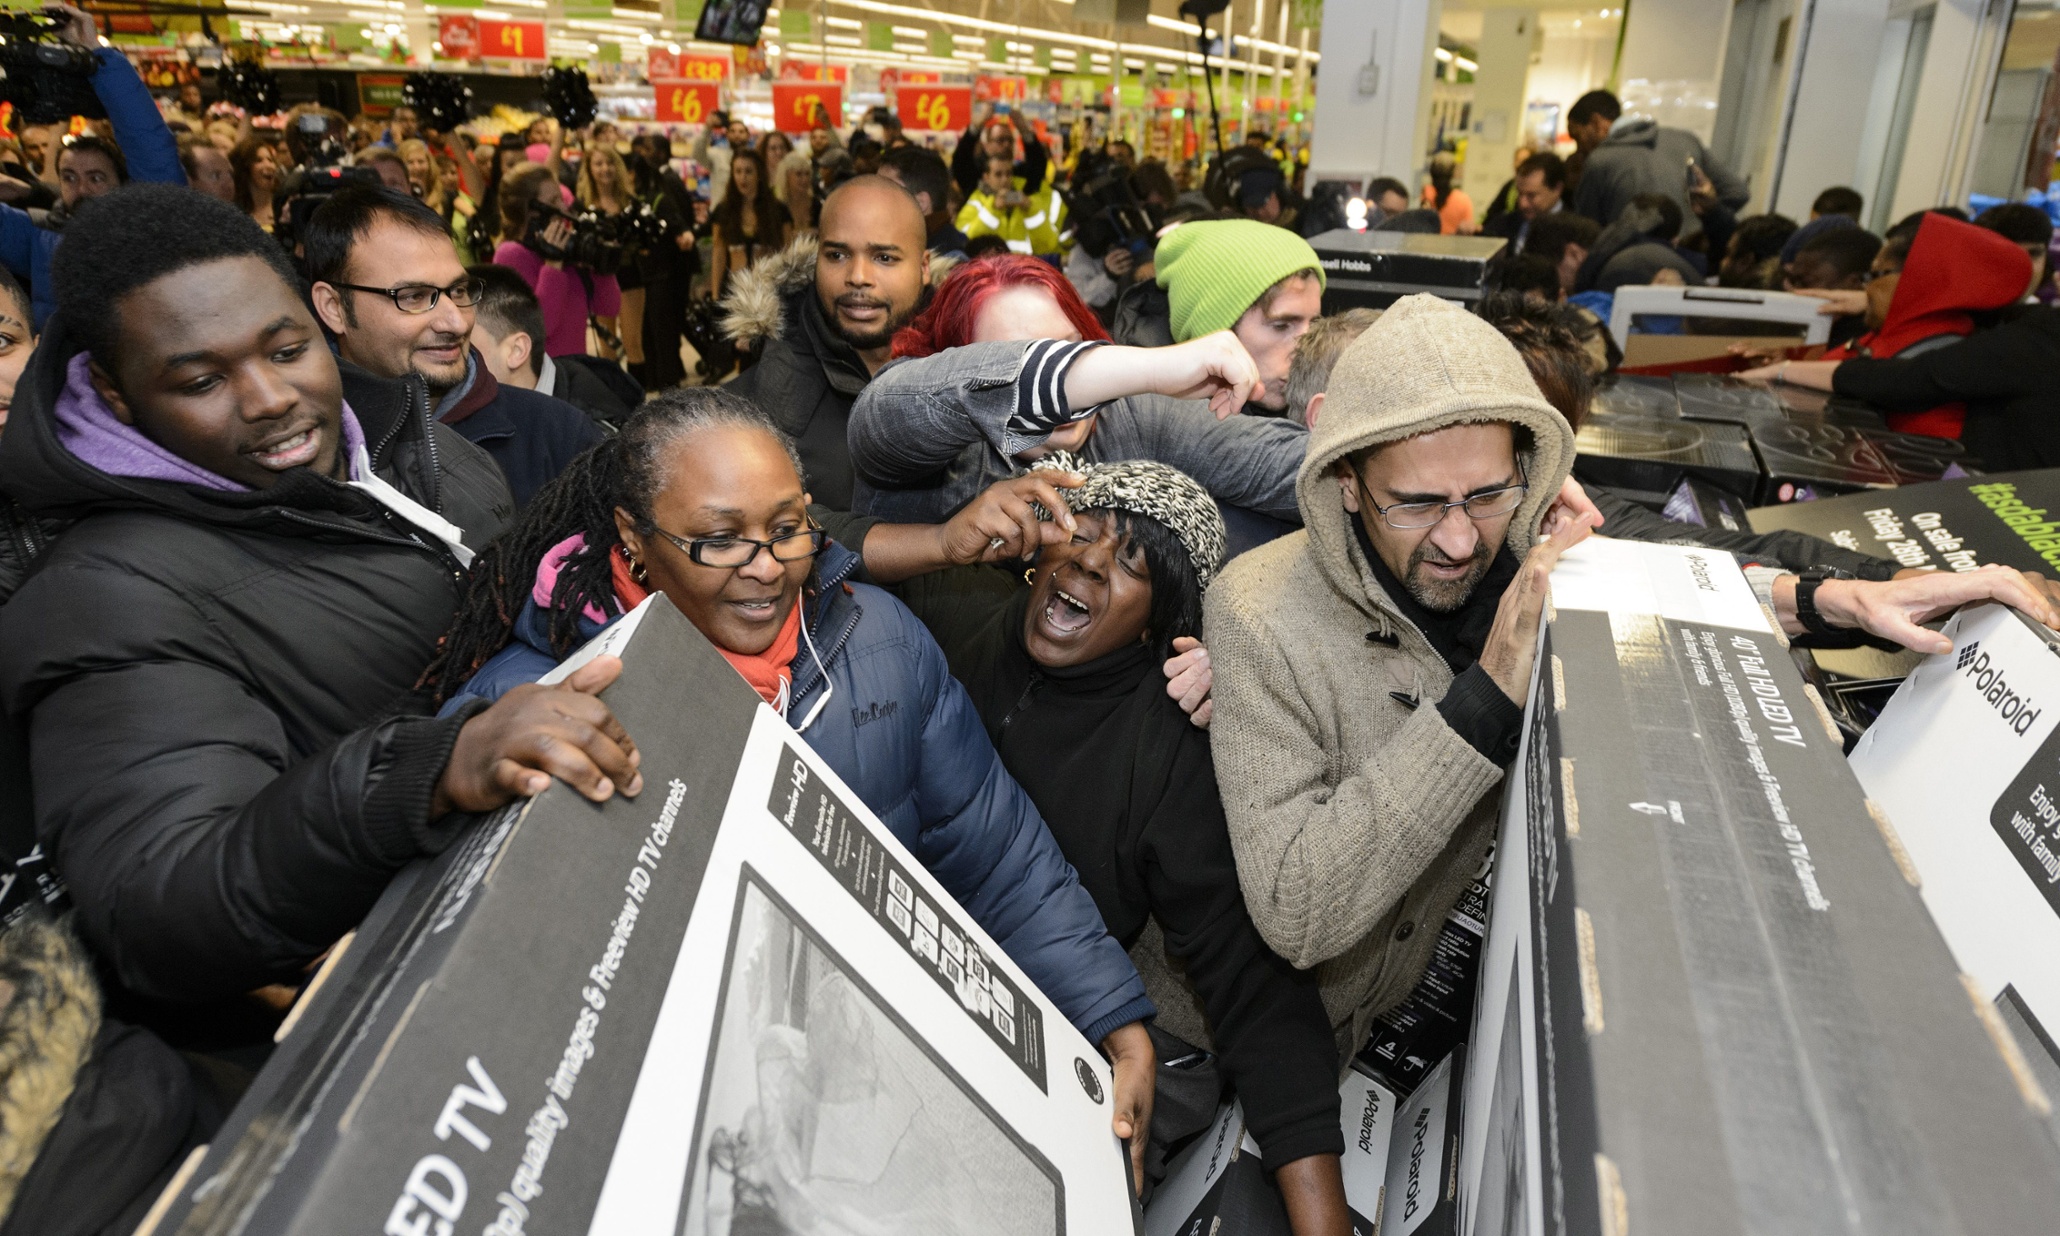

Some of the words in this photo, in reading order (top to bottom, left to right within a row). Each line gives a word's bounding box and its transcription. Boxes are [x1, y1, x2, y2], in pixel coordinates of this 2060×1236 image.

[501, 24, 523, 57] £1
[672, 88, 702, 124] £6
[794, 94, 821, 126] £7
[916, 93, 950, 131] £6
[1320, 258, 1341, 271] ssell
[1341, 260, 1372, 272] Hobbs
[1863, 508, 1906, 541] Friday
[1886, 538, 1931, 568] 28th
[1911, 512, 1942, 531] On
[1968, 482, 2060, 573] #asdablac
[1924, 528, 1964, 553] sale
[1687, 559, 1720, 592] Polaroid
[1700, 631, 1717, 647] Enjoy
[1736, 654, 1771, 677] Full
[1746, 676, 1780, 697] HD
[1966, 651, 2042, 737] Polaroid
[1755, 696, 1793, 723] LED
[1732, 719, 1759, 745] quality
[1769, 725, 1807, 748] TV
[790, 759, 809, 793] HD
[1746, 744, 1770, 775] images
[651, 777, 689, 847] channels
[783, 788, 800, 828] Freeview
[1761, 782, 1791, 824] Freeview
[2029, 783, 2060, 828] Enjoy
[1777, 823, 1803, 842] HD
[2010, 810, 2036, 846] with
[2030, 834, 2060, 884] family
[637, 836, 662, 870] TV
[1785, 841, 1811, 861] TV
[625, 866, 652, 903] HD
[1461, 891, 1484, 910] TRA
[1465, 880, 1491, 898] EDT
[1790, 858, 1831, 912] channels
[1457, 899, 1487, 921] DEFIN
[589, 896, 640, 991] Freeview
[582, 985, 607, 1011] &
[545, 1006, 601, 1100] images
[433, 1055, 508, 1152] TV
[1359, 1098, 1379, 1155] Polaroid
[511, 1093, 569, 1202] quality
[1403, 1121, 1429, 1223] Polaroid
